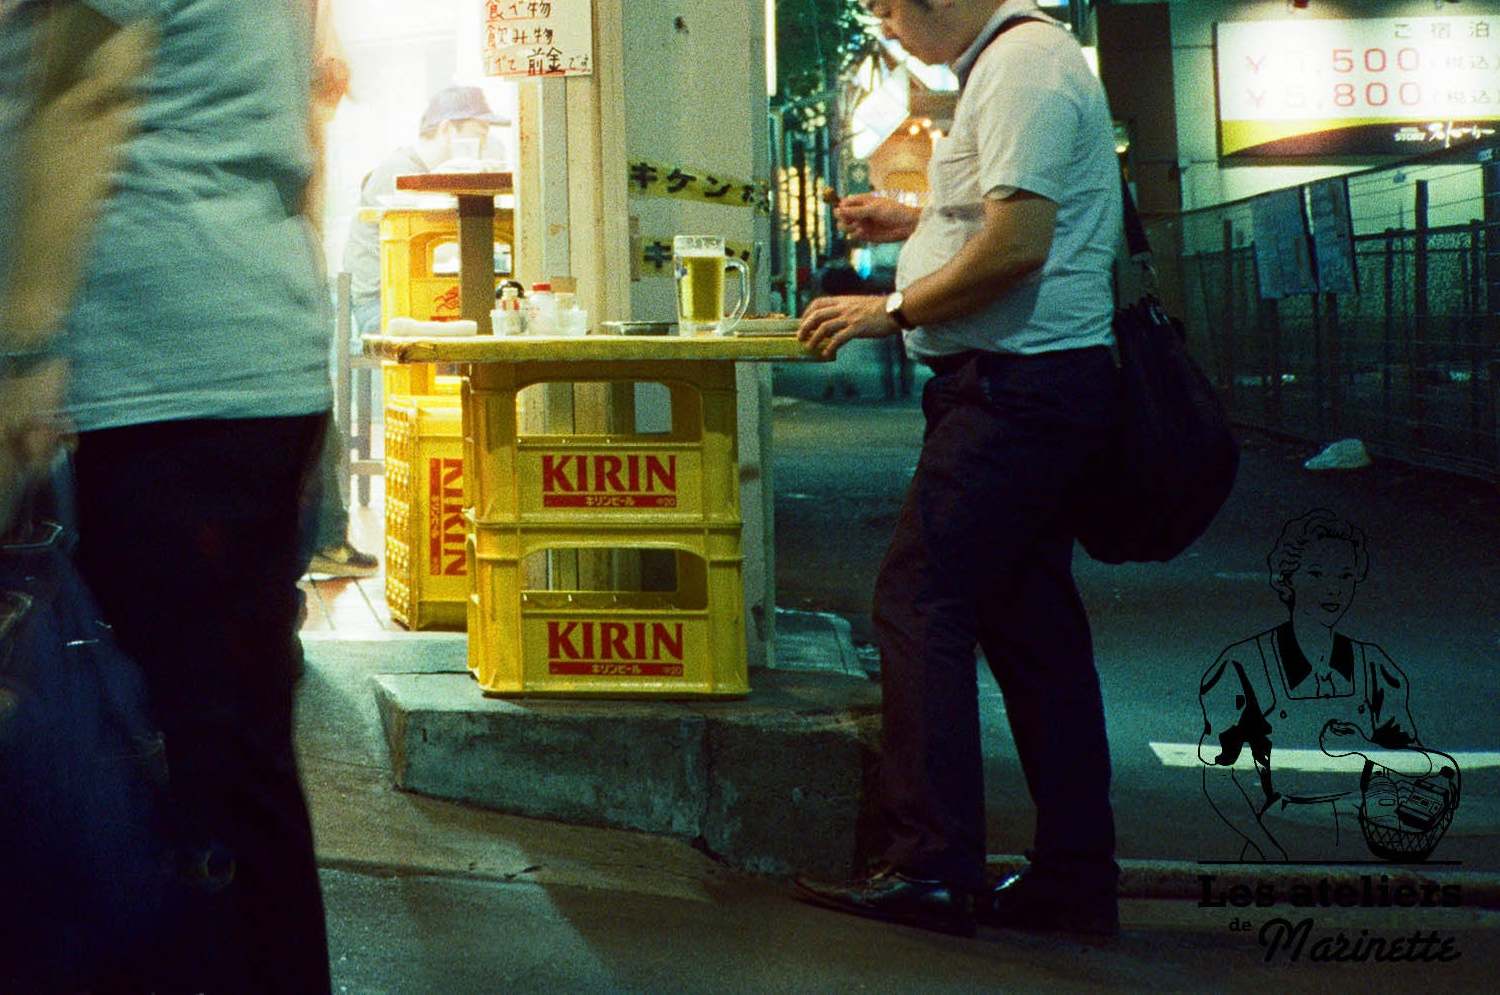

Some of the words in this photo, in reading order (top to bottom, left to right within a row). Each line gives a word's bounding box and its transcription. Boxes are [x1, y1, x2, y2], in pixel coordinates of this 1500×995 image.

[485, 24, 554, 49] 飲み物
[542, 454, 677, 492] KIRIN
[547, 621, 683, 661] KIRIN
[591, 664, 642, 674] キリンビール
